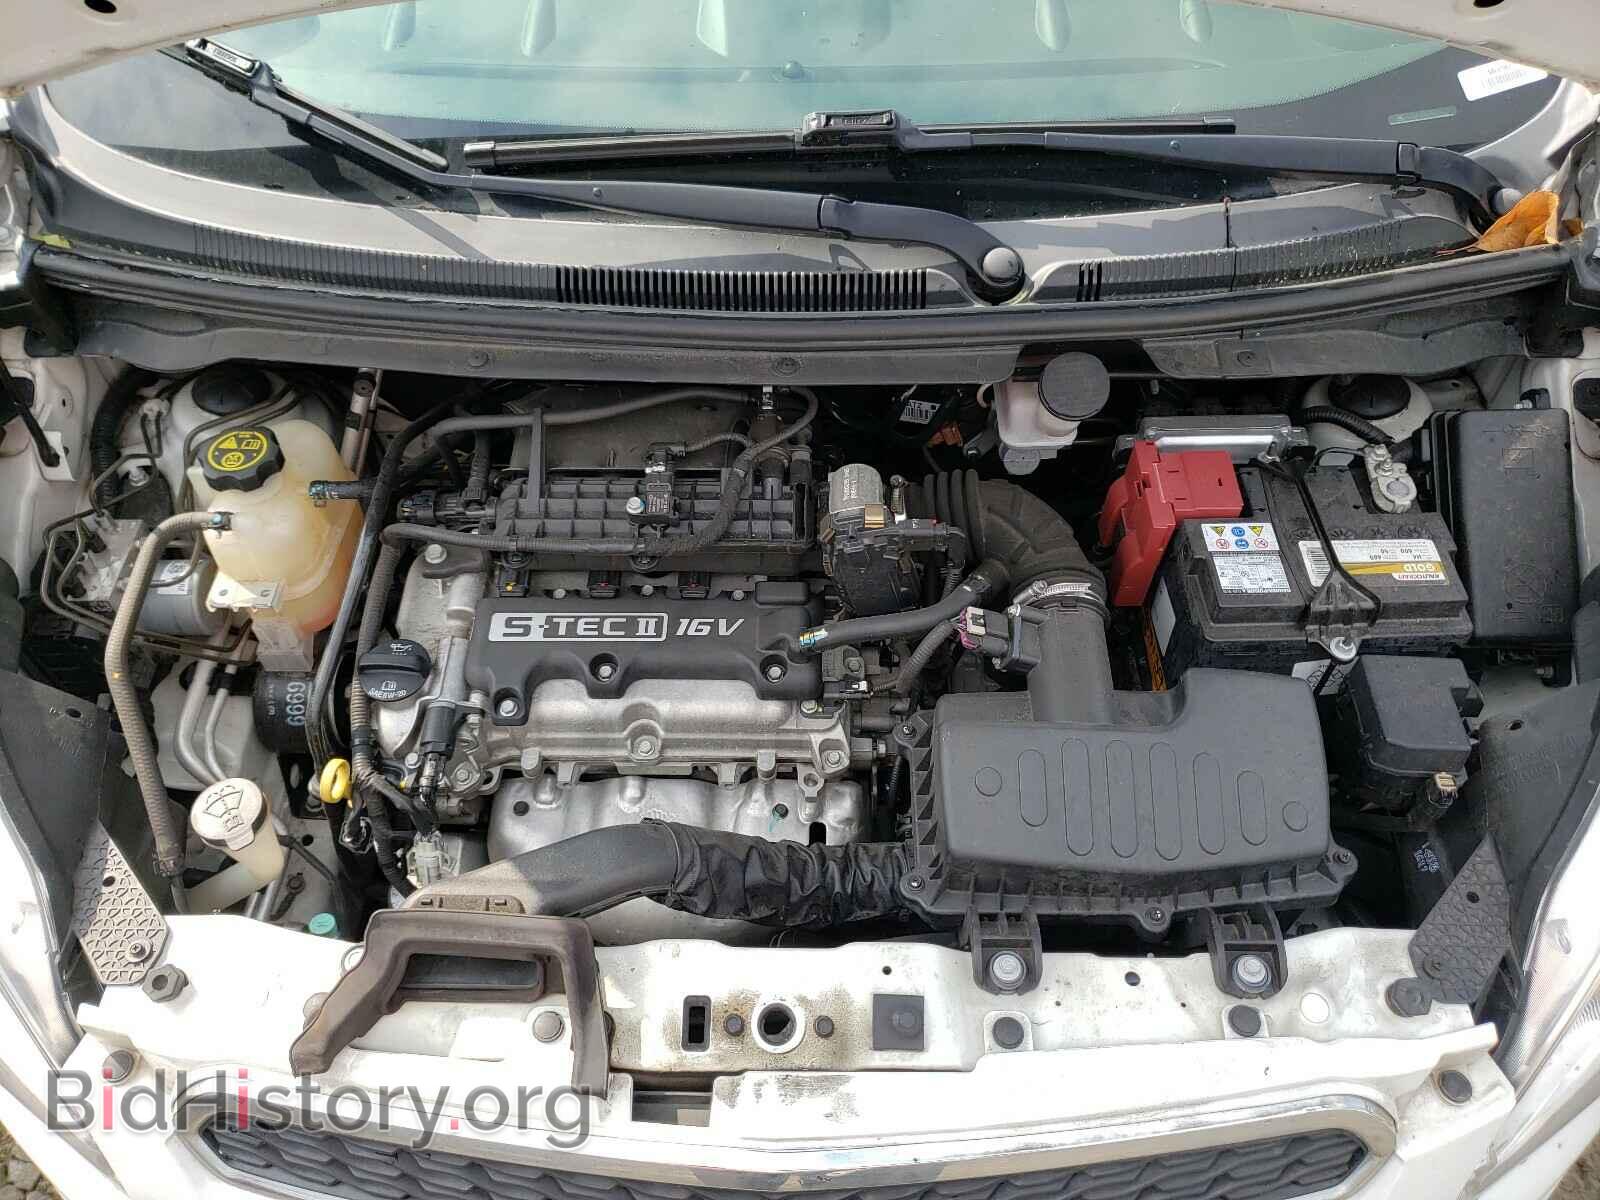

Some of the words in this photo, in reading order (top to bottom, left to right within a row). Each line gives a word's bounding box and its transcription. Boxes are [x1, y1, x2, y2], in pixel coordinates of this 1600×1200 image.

[1403, 563, 1433, 572] GOLD
[502, 616, 627, 637] S-TEC
[675, 618, 745, 636] 16V
